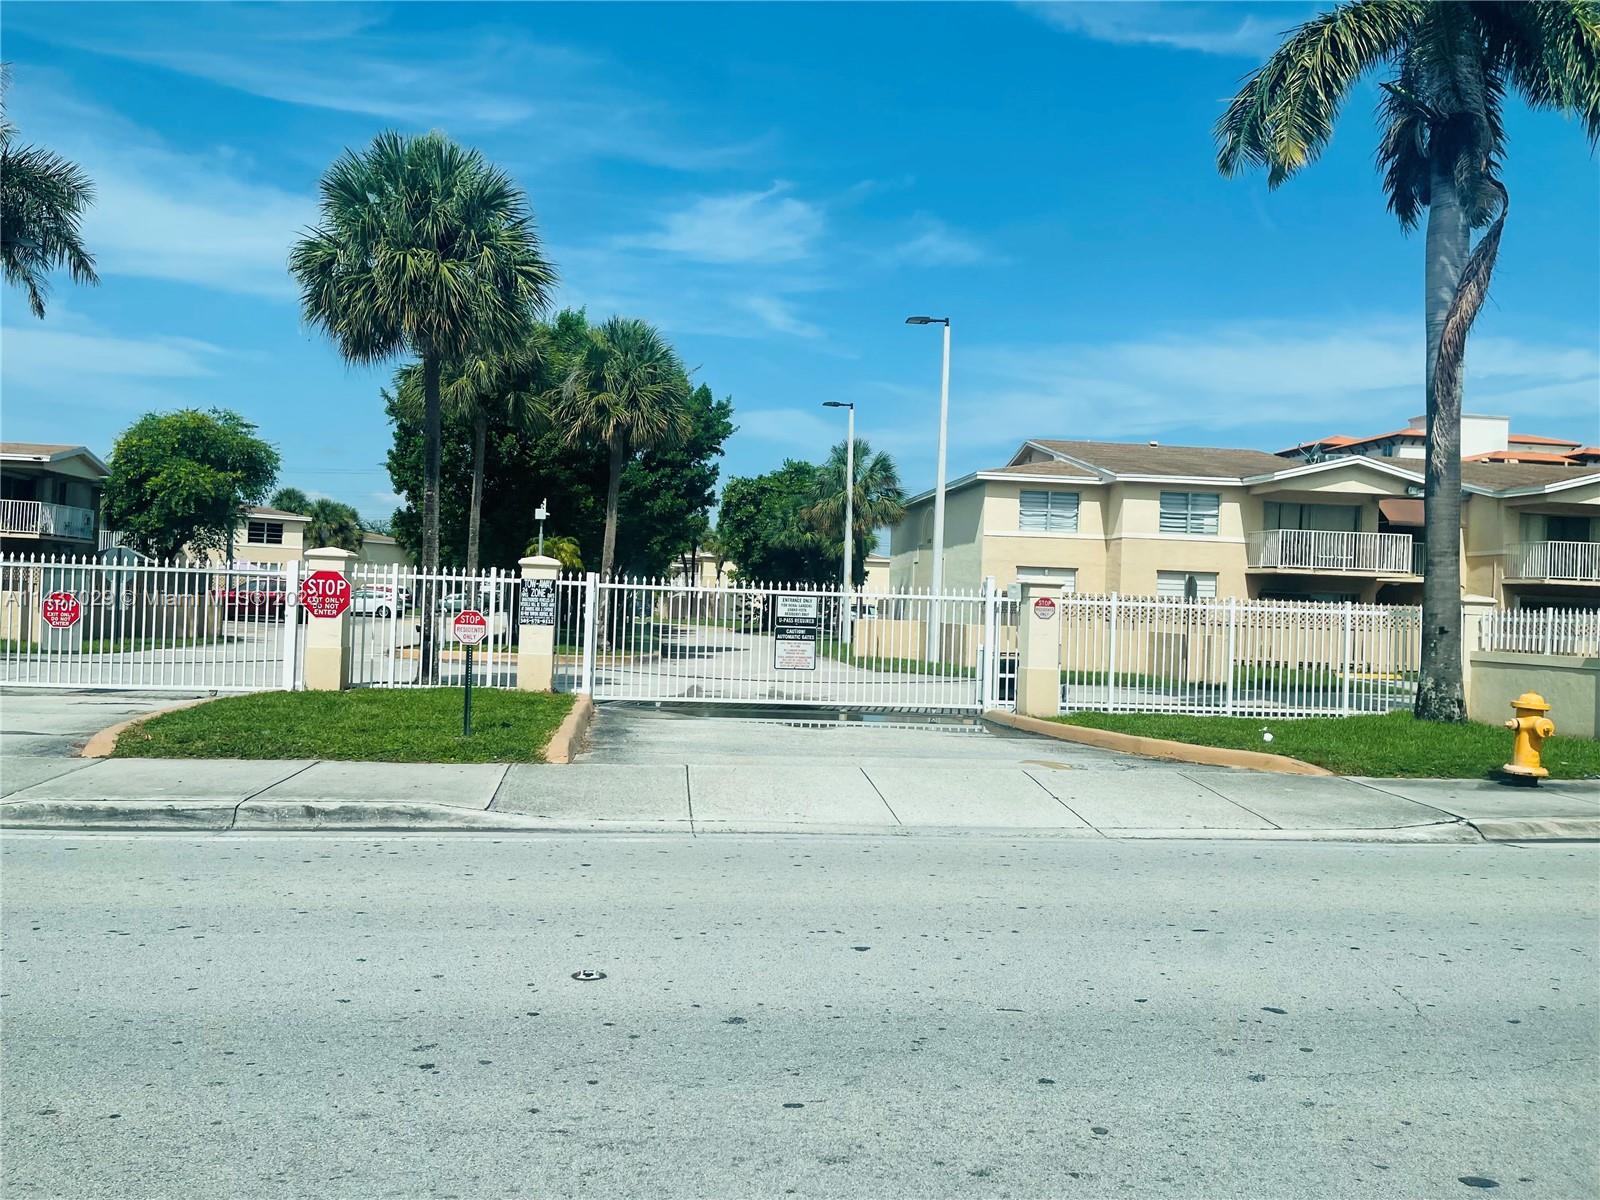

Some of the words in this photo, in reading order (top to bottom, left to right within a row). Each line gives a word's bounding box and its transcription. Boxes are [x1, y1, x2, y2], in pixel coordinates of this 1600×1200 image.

[307, 579, 346, 595] STOP
[530, 588, 546, 597] ZONE
[47, 599, 77, 611] STOP
[460, 615, 480, 624] STOP
